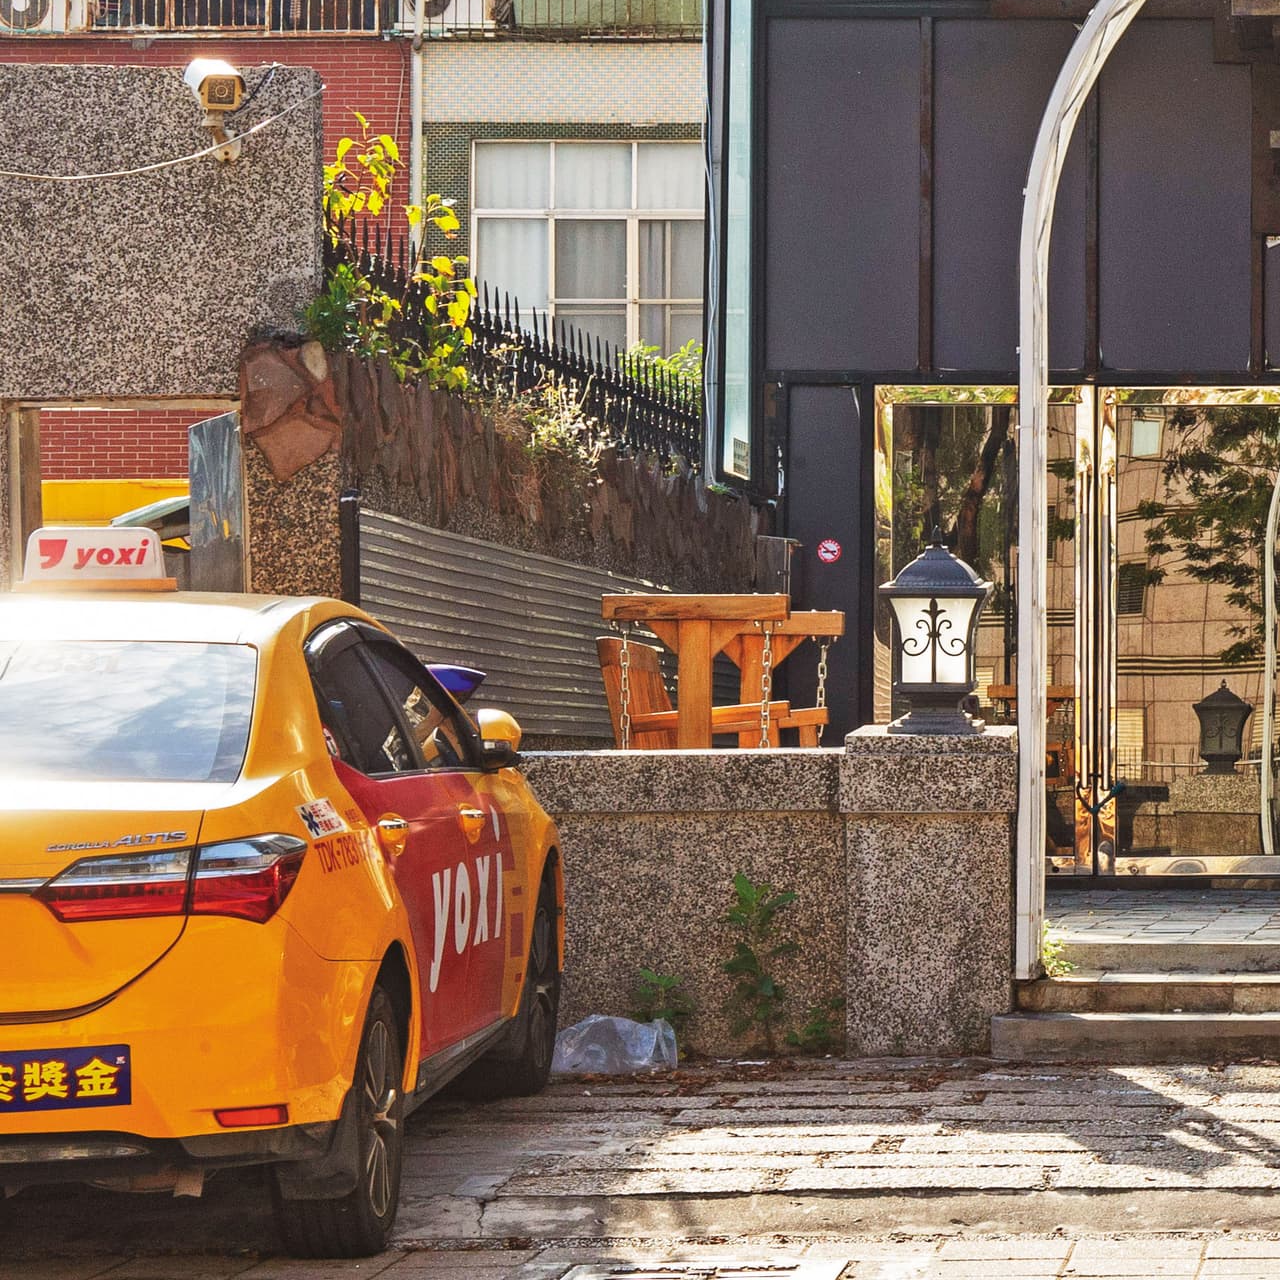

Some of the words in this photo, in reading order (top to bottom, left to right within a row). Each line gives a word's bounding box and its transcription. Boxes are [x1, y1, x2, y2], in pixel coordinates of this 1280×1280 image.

[73, 538, 150, 570] yoxi
[47, 841, 110, 852] COROLLA
[111, 830, 188, 848] ALTIS
[429, 804, 503, 993] yoxi
